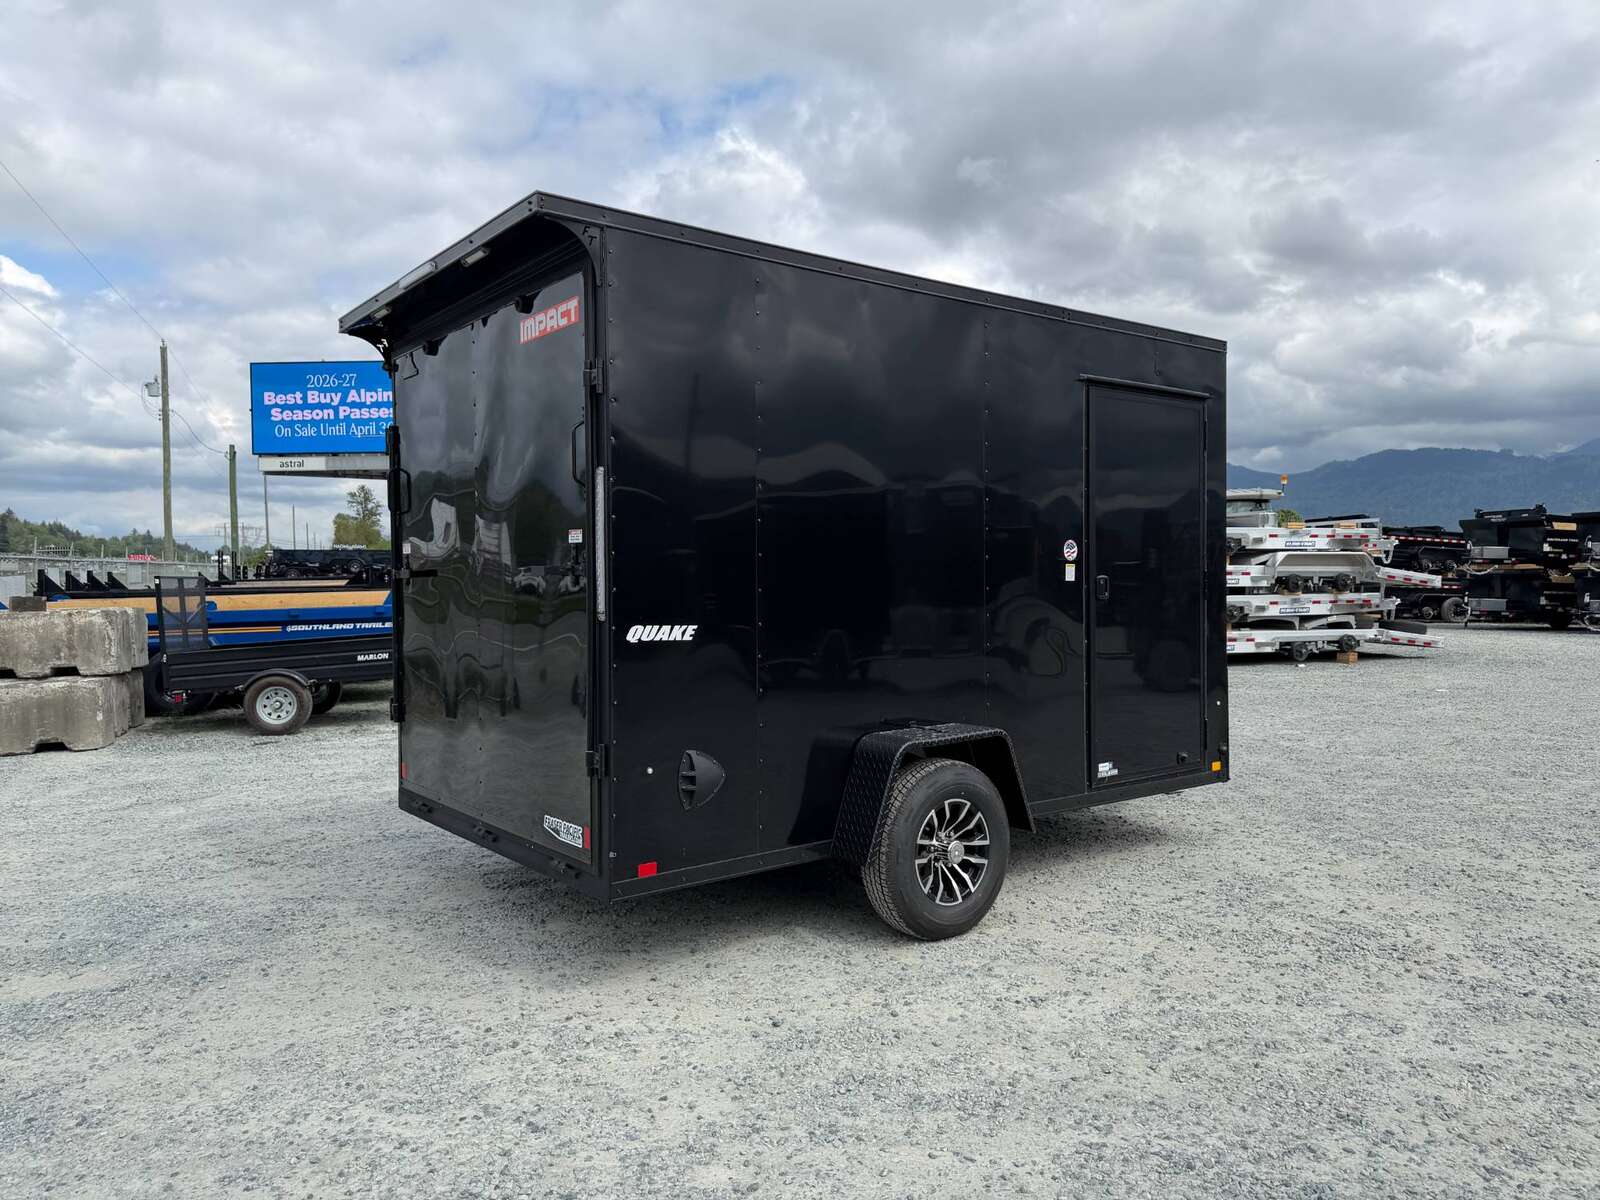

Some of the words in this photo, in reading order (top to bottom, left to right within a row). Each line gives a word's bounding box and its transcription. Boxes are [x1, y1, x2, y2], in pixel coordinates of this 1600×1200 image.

[520, 297, 579, 344] IMPACT
[306, 373, 357, 388] 2026-27
[263, 391, 304, 406] Best
[307, 390, 342, 406] Buy
[270, 407, 335, 422] Season
[274, 424, 292, 438] On
[294, 423, 318, 437] Sale
[320, 423, 347, 437] Until
[350, 422, 376, 438] April
[279, 460, 304, 468] astral
[289, 623, 354, 631] SOUTHLAND
[625, 624, 698, 643] QUAKE
[357, 653, 389, 661] MARLON
